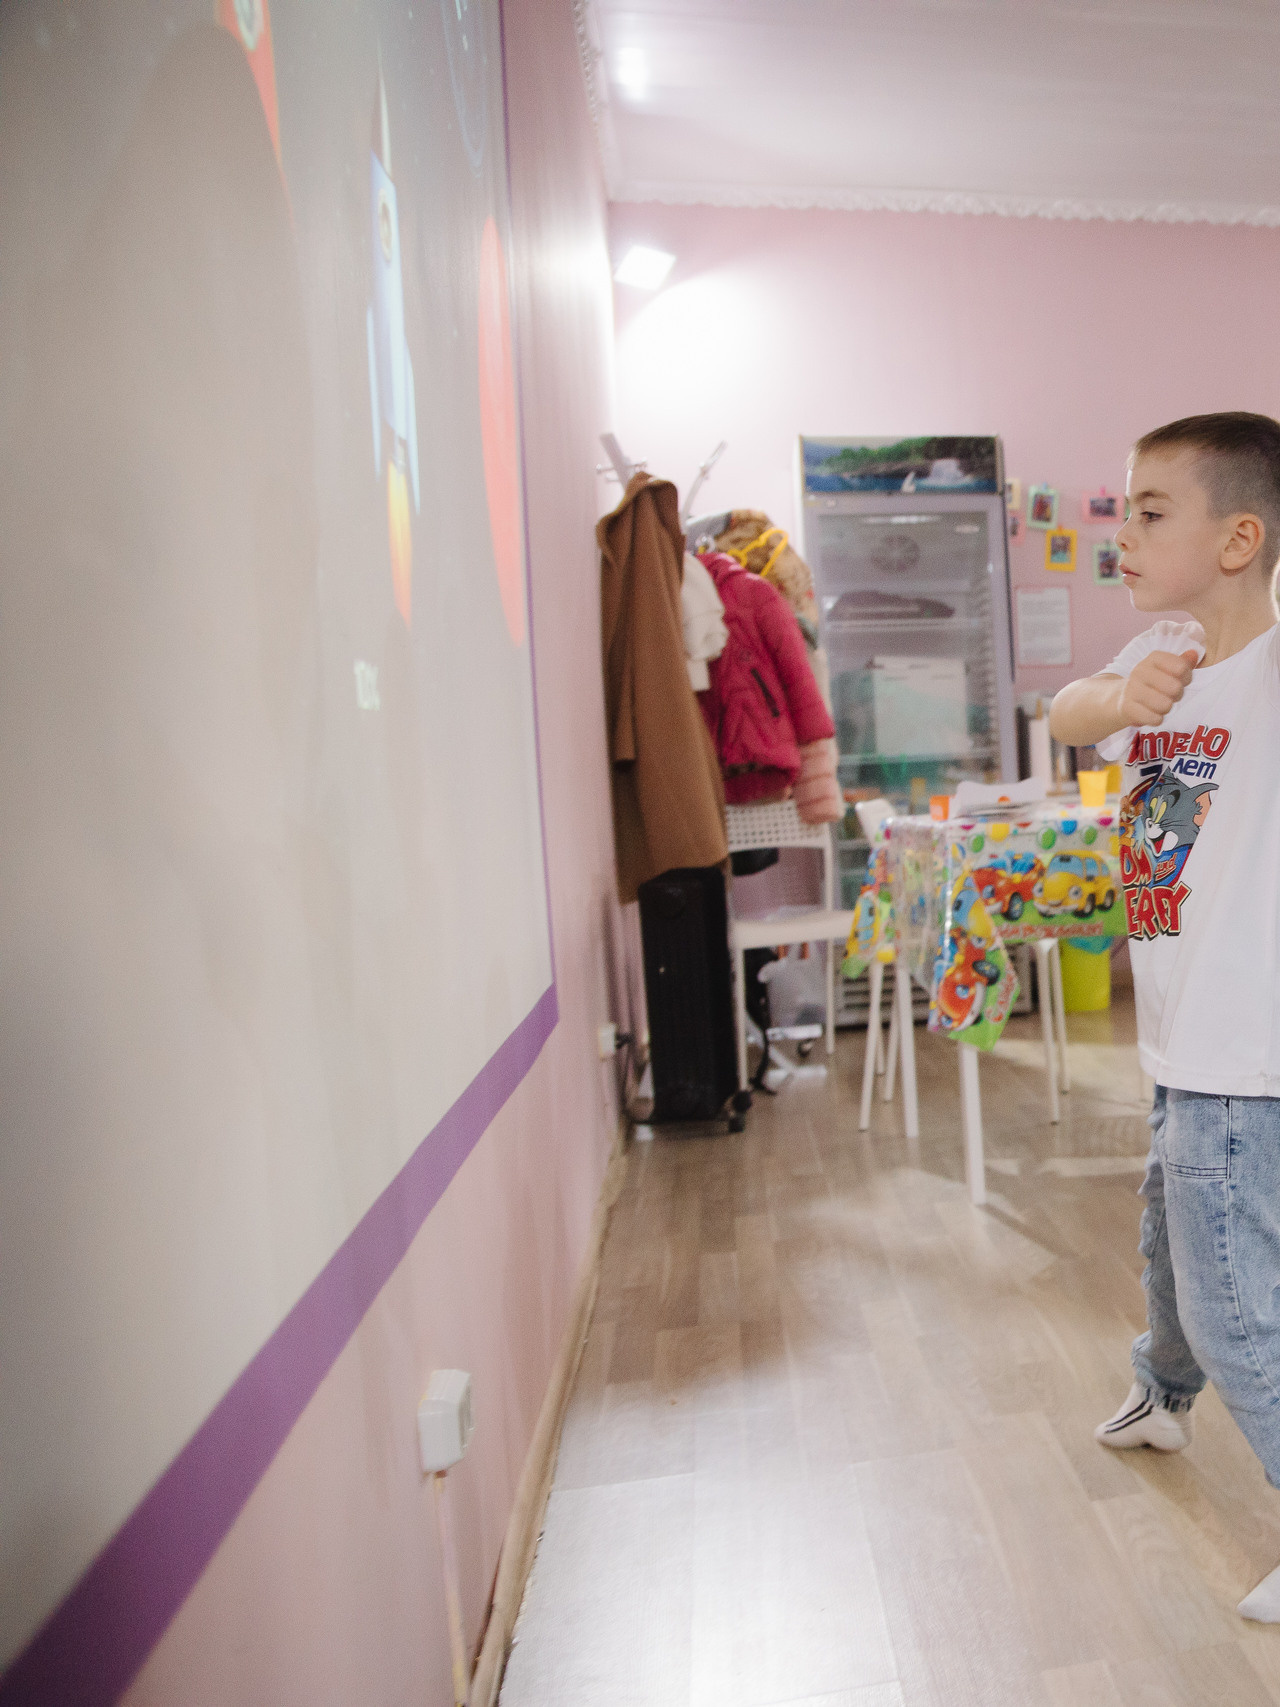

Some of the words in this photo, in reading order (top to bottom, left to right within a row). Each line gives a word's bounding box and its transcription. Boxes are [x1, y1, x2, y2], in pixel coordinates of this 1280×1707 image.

[1172, 757, 1217, 780] лет
[1119, 843, 1153, 887] OM
[1123, 881, 1192, 940] ERRY
